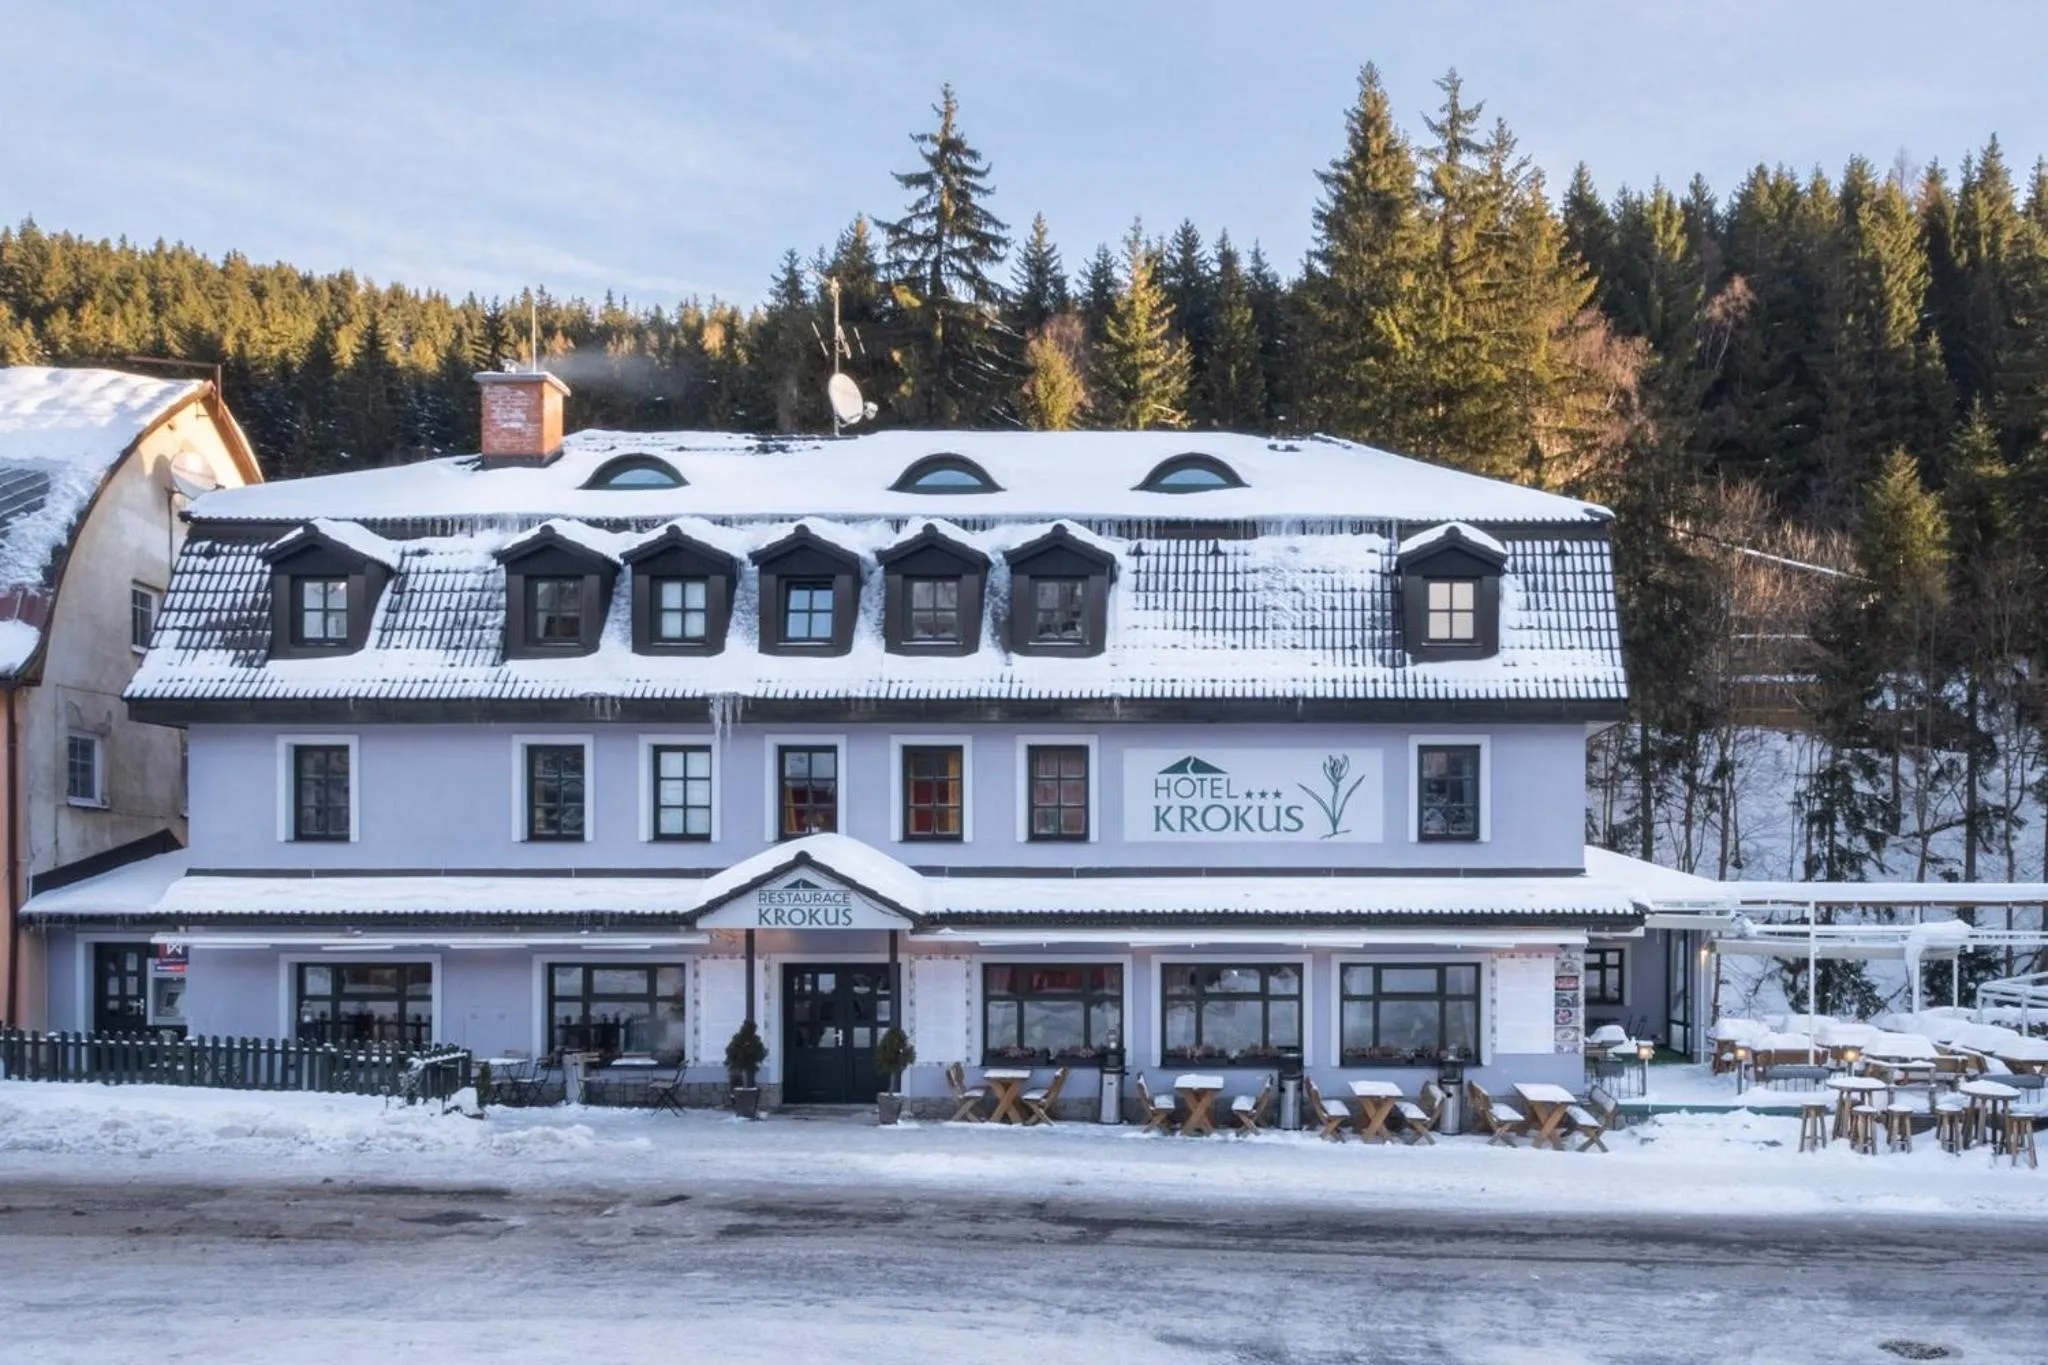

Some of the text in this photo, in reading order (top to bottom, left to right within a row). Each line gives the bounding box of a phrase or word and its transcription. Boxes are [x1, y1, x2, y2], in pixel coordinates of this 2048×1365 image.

[1154, 777, 1239, 799] HOTEL
[1153, 804, 1304, 833] KROKUS
[758, 891, 850, 904] RESTAURACE
[758, 907, 853, 926] KROKUS
